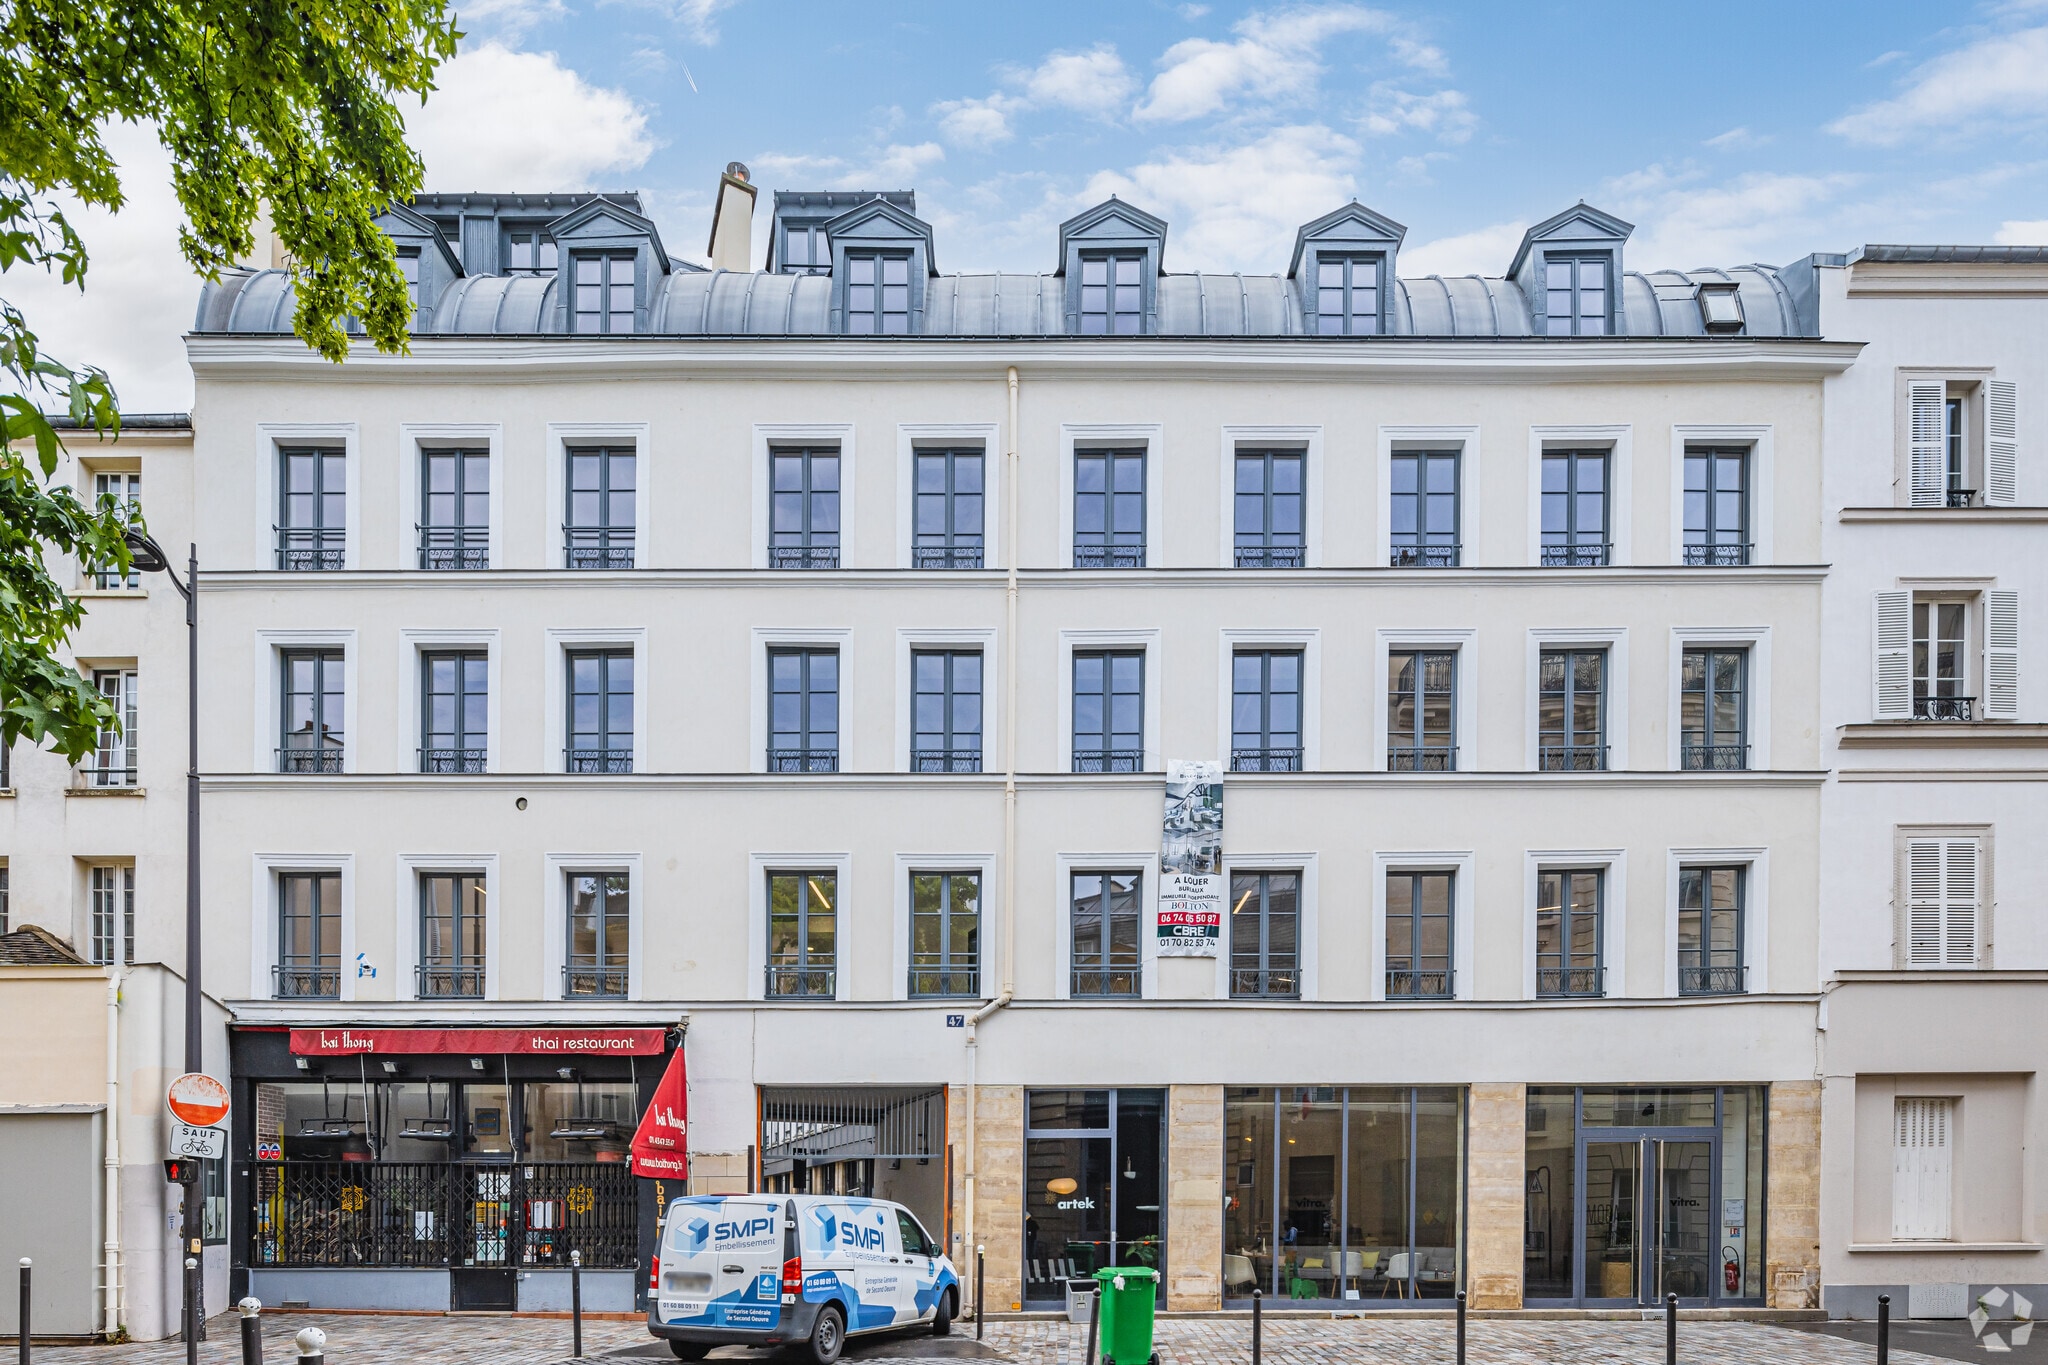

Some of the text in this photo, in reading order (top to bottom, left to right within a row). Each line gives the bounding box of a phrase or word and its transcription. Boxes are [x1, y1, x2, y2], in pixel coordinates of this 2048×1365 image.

[1184, 876, 1208, 886] LOUER
[1172, 902, 1208, 910] BOLTON
[1161, 914, 1171, 922] 06
[1196, 914, 1206, 922] 50
[1173, 926, 1204, 936] CBRE
[948, 1016, 962, 1026] 47
[320, 1031, 374, 1052] bai thong
[532, 1036, 634, 1050] thai restaurant
[182, 1128, 216, 1138] SAUF
[1058, 1197, 1095, 1210] artek
[1670, 1198, 1700, 1206] vitra.
[714, 1217, 774, 1240] SMPI
[841, 1222, 884, 1252] SMPI
[715, 1238, 776, 1251] Embellissement
